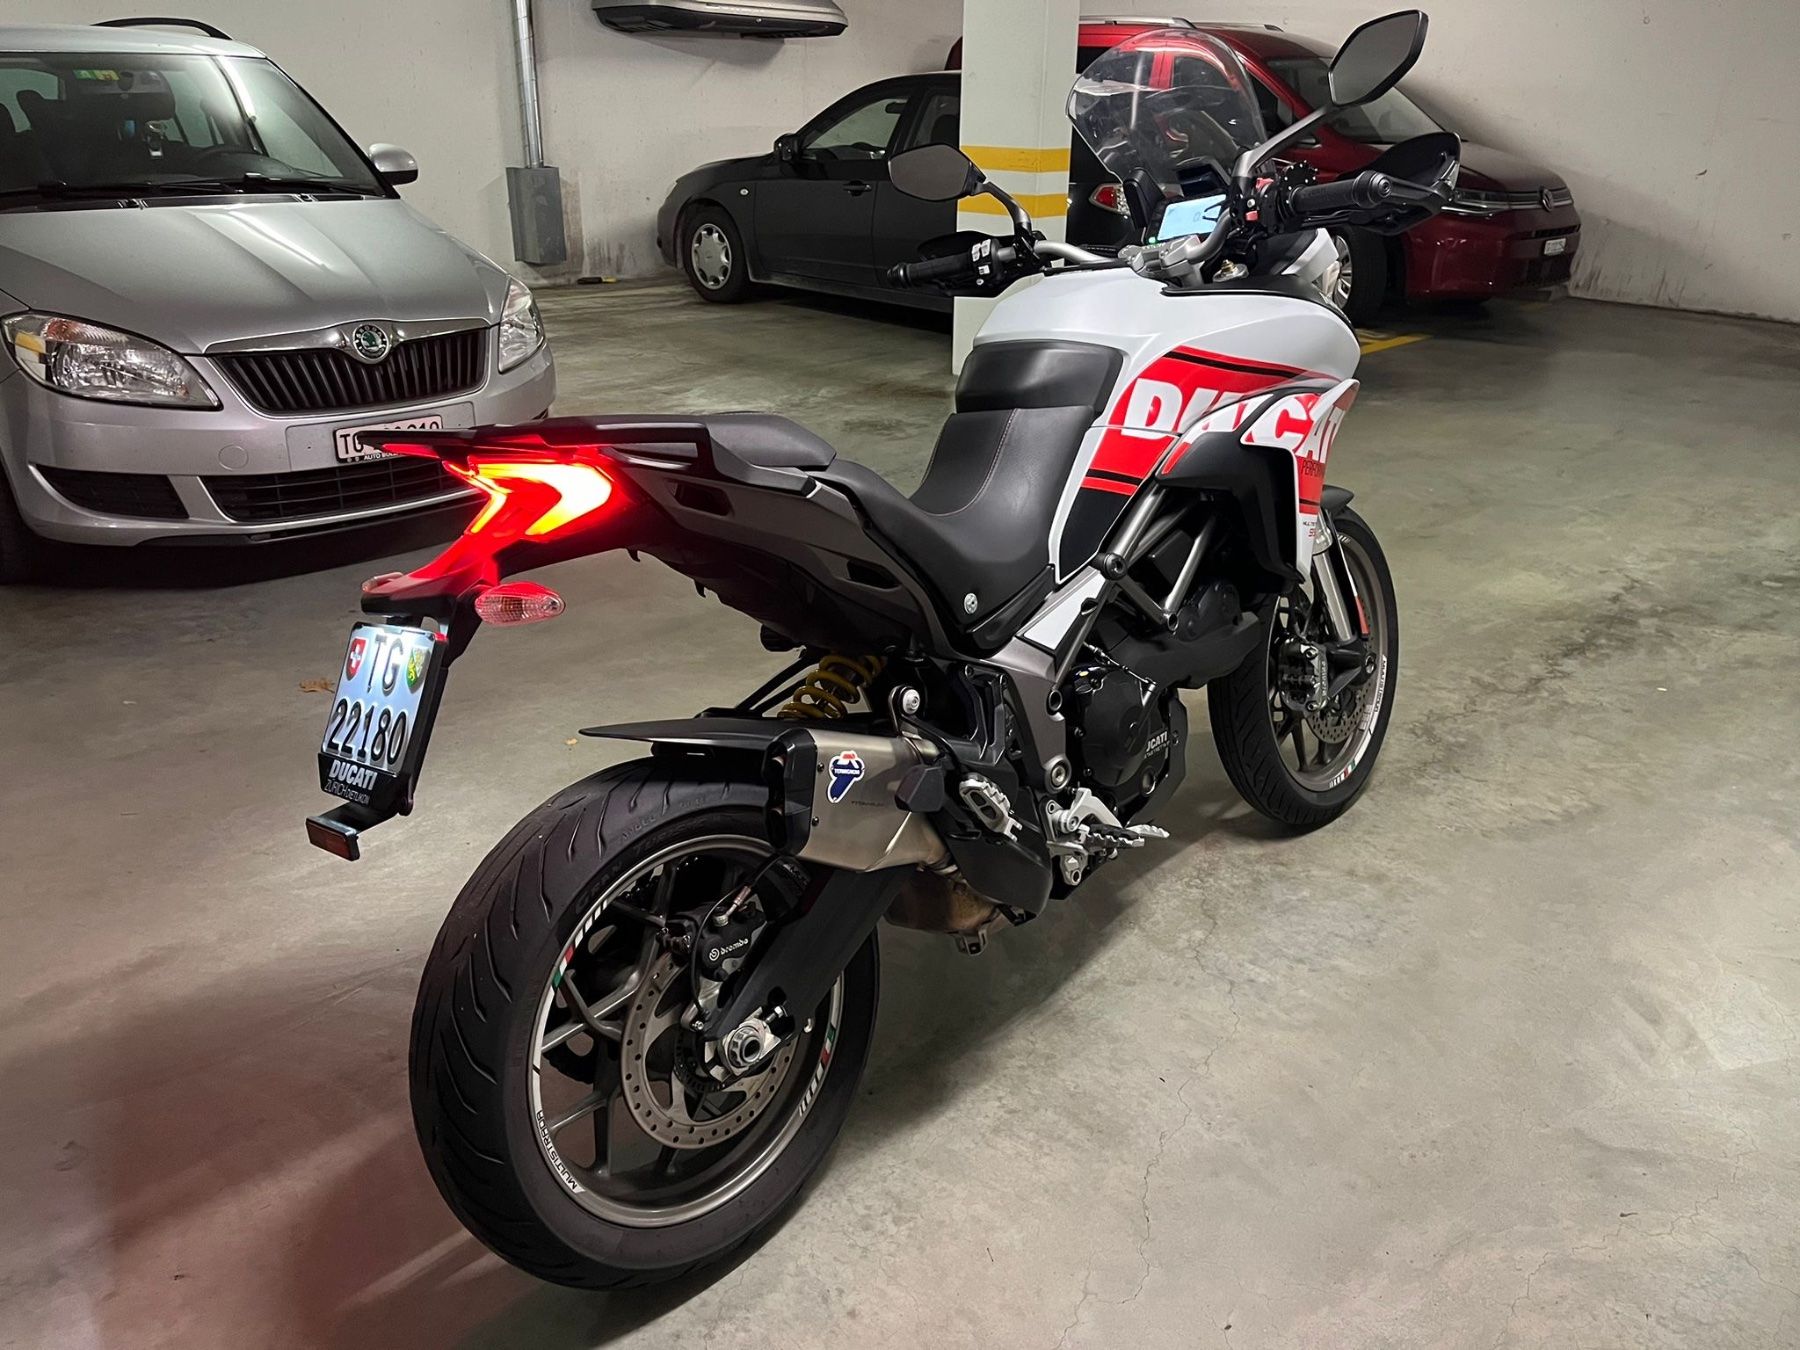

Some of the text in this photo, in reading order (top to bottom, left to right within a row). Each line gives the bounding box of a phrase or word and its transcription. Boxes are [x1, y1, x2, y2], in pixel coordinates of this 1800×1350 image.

[367, 634, 404, 697] TG
[327, 698, 407, 766] 22180
[329, 759, 378, 791] DUCATI
[536, 1109, 578, 1190] MULTISTRADA
